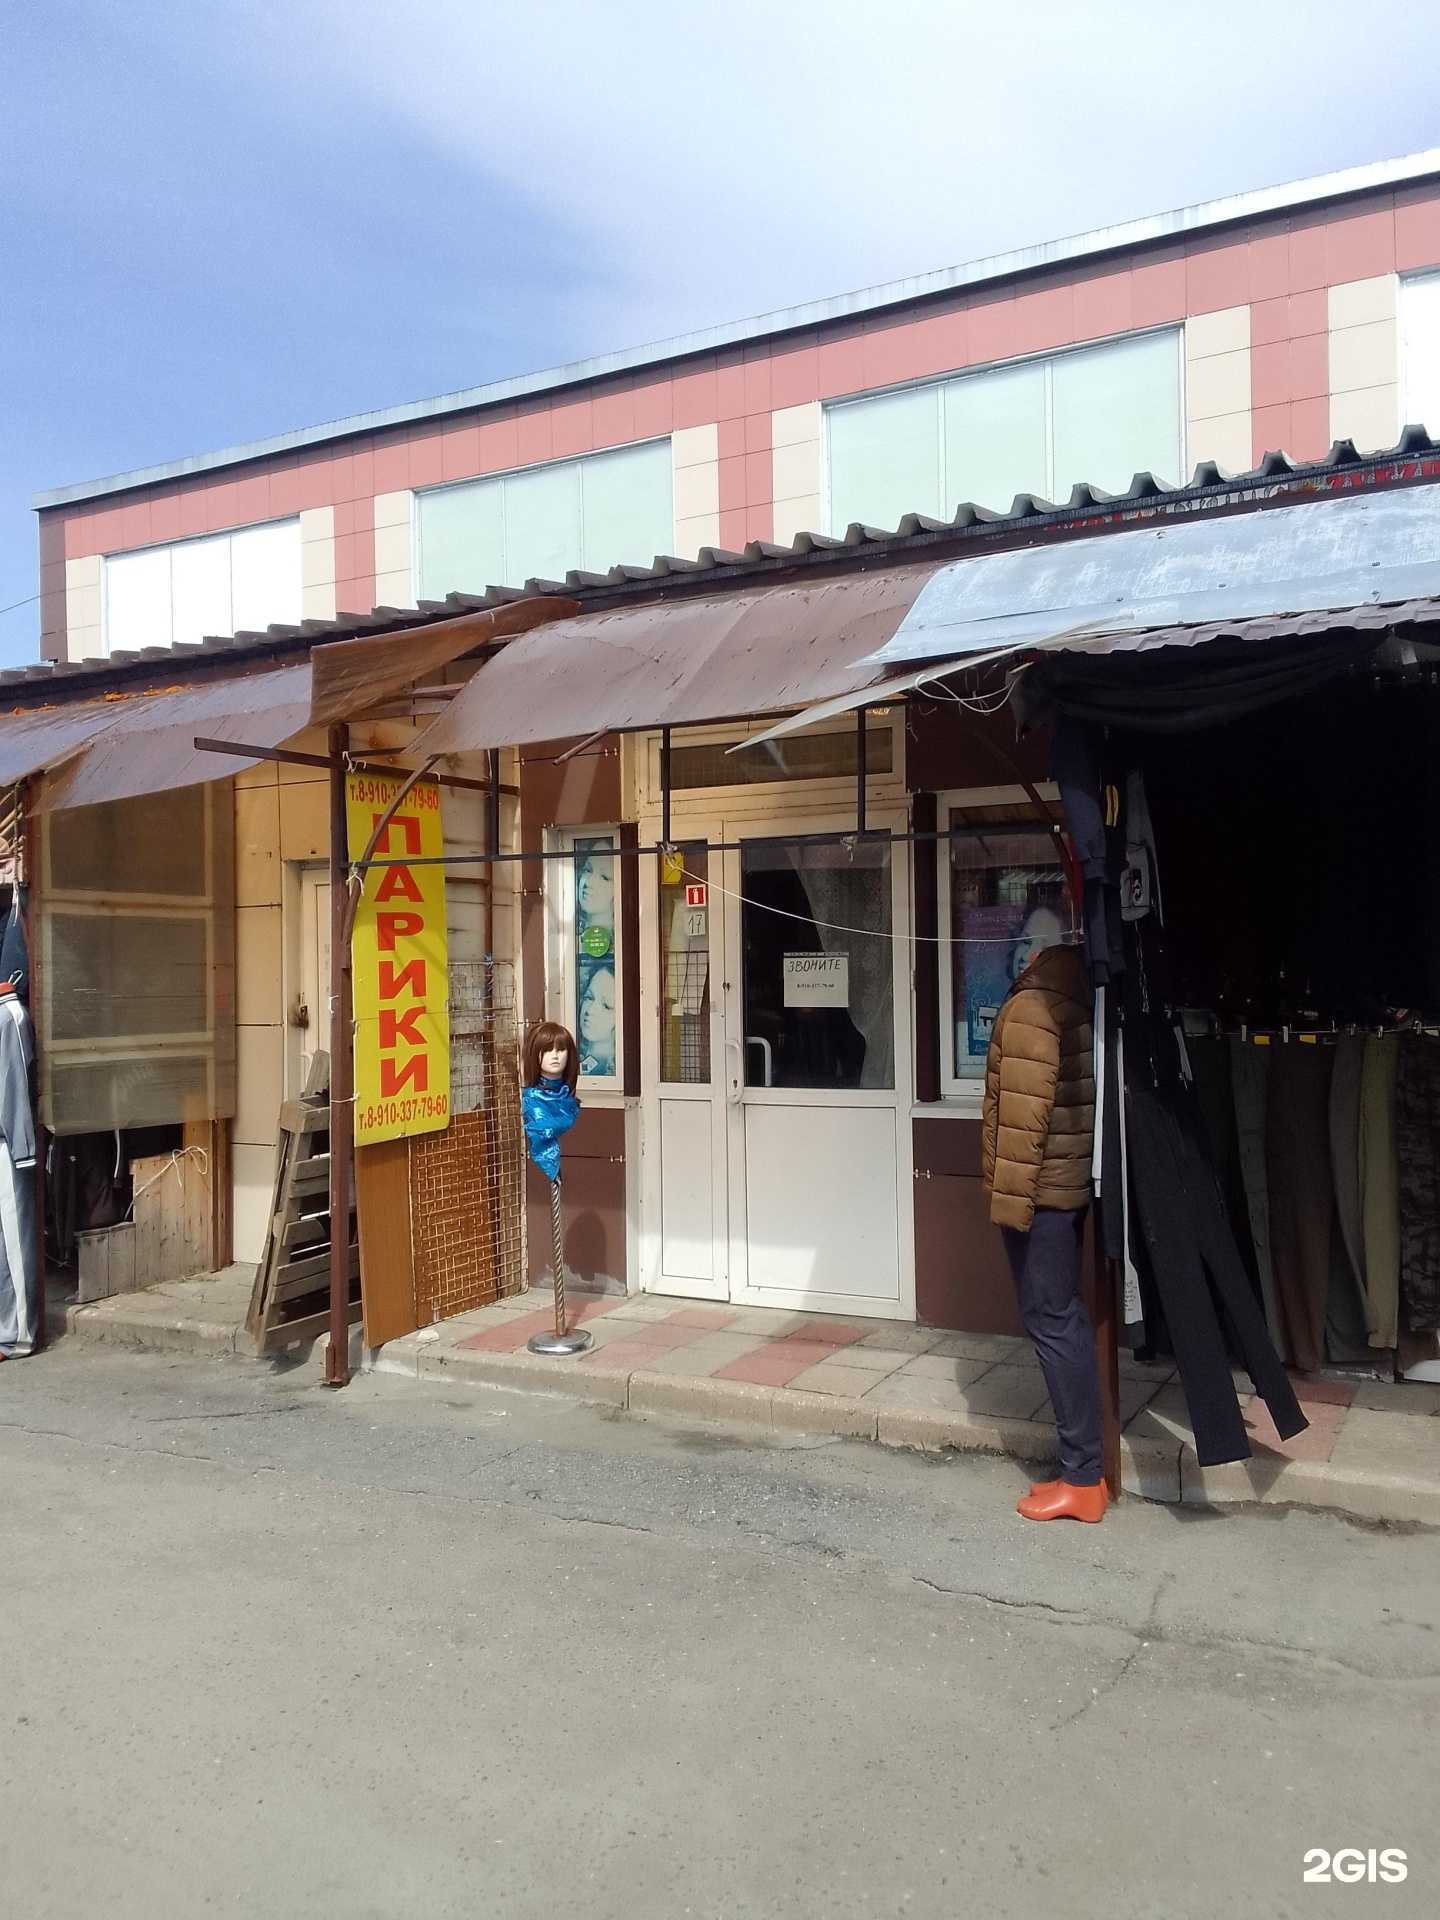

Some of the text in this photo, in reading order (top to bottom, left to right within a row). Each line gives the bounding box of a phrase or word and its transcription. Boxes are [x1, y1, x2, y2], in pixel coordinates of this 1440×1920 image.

[688, 913, 703, 935] 17
[372, 813, 429, 1098] ПАРИКИ
[788, 959, 841, 973] ЗВОНИТЕ
[359, 1094, 448, 1130] т.8-910-337-79-60
